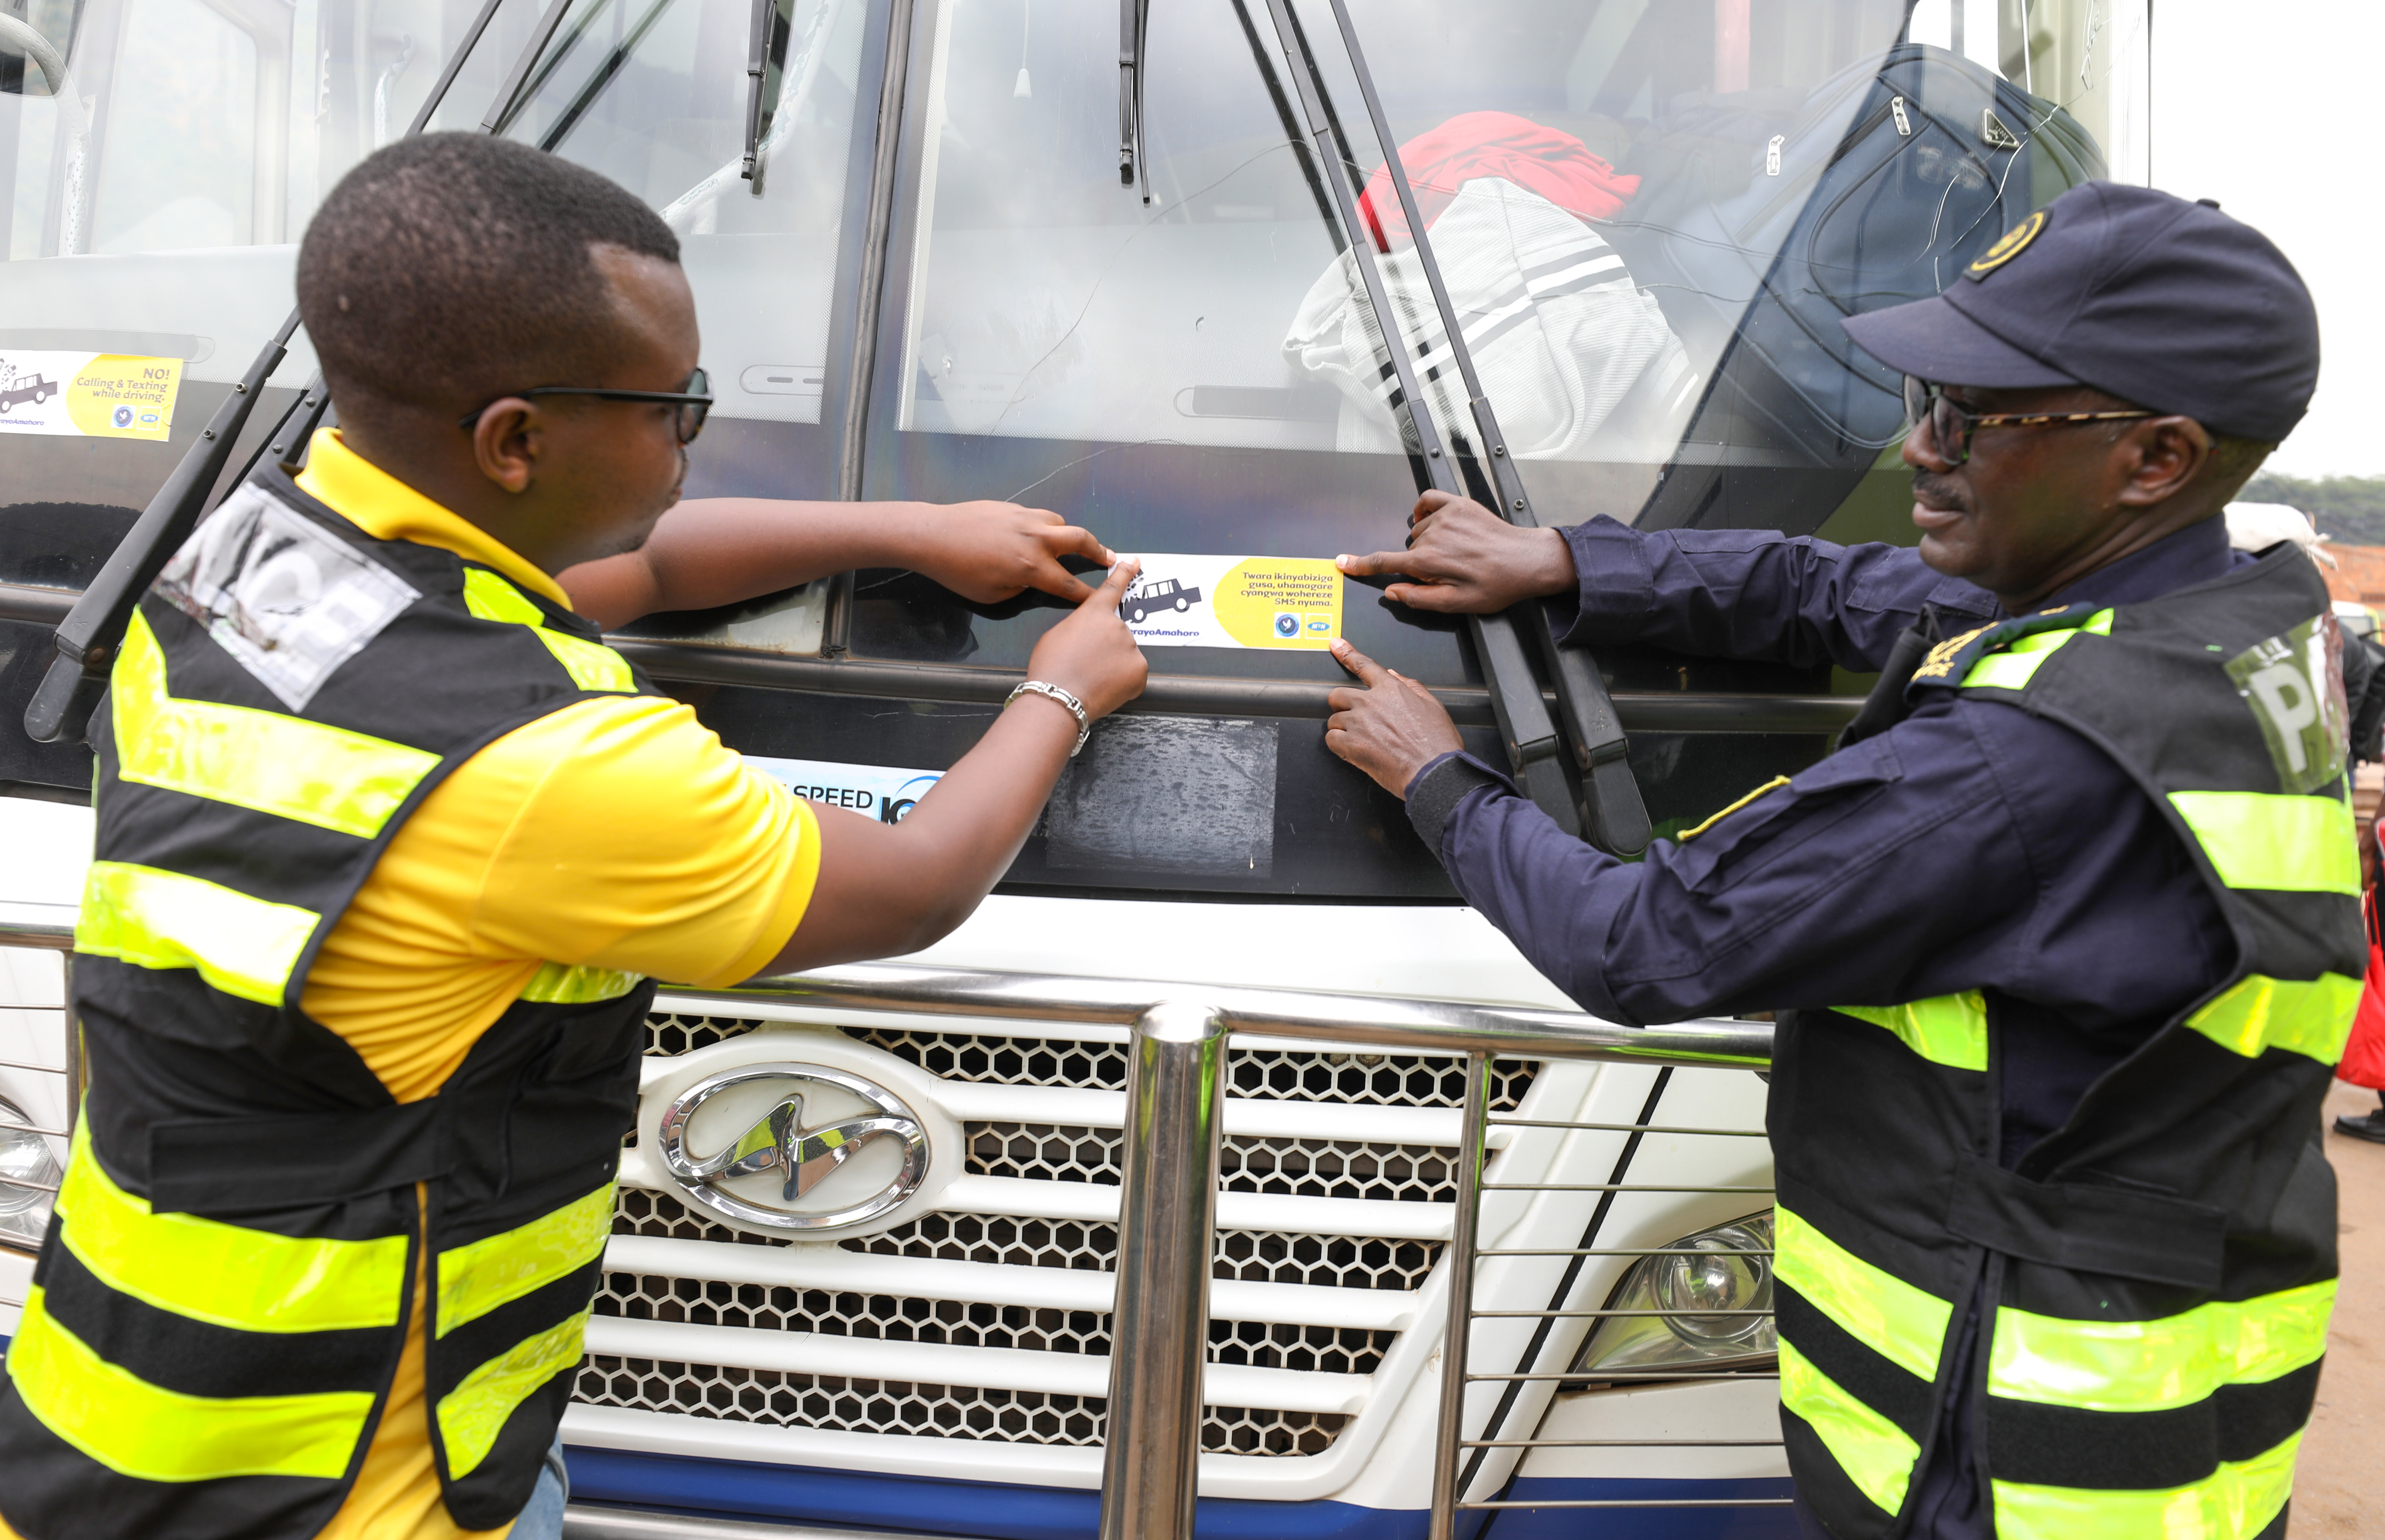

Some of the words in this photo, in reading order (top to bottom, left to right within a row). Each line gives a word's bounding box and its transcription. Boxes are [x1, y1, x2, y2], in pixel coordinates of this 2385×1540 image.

[143, 368, 170, 379] NO!
[77, 377, 114, 390] Calling
[117, 379, 123, 388] &
[127, 380, 168, 393] Texting
[93, 389, 121, 398] while
[123, 390, 165, 402] driving.
[1274, 573, 1333, 582] ikinyabiziga
[1277, 582, 1333, 591] uhamagare
[794, 785, 873, 808] SPEED
